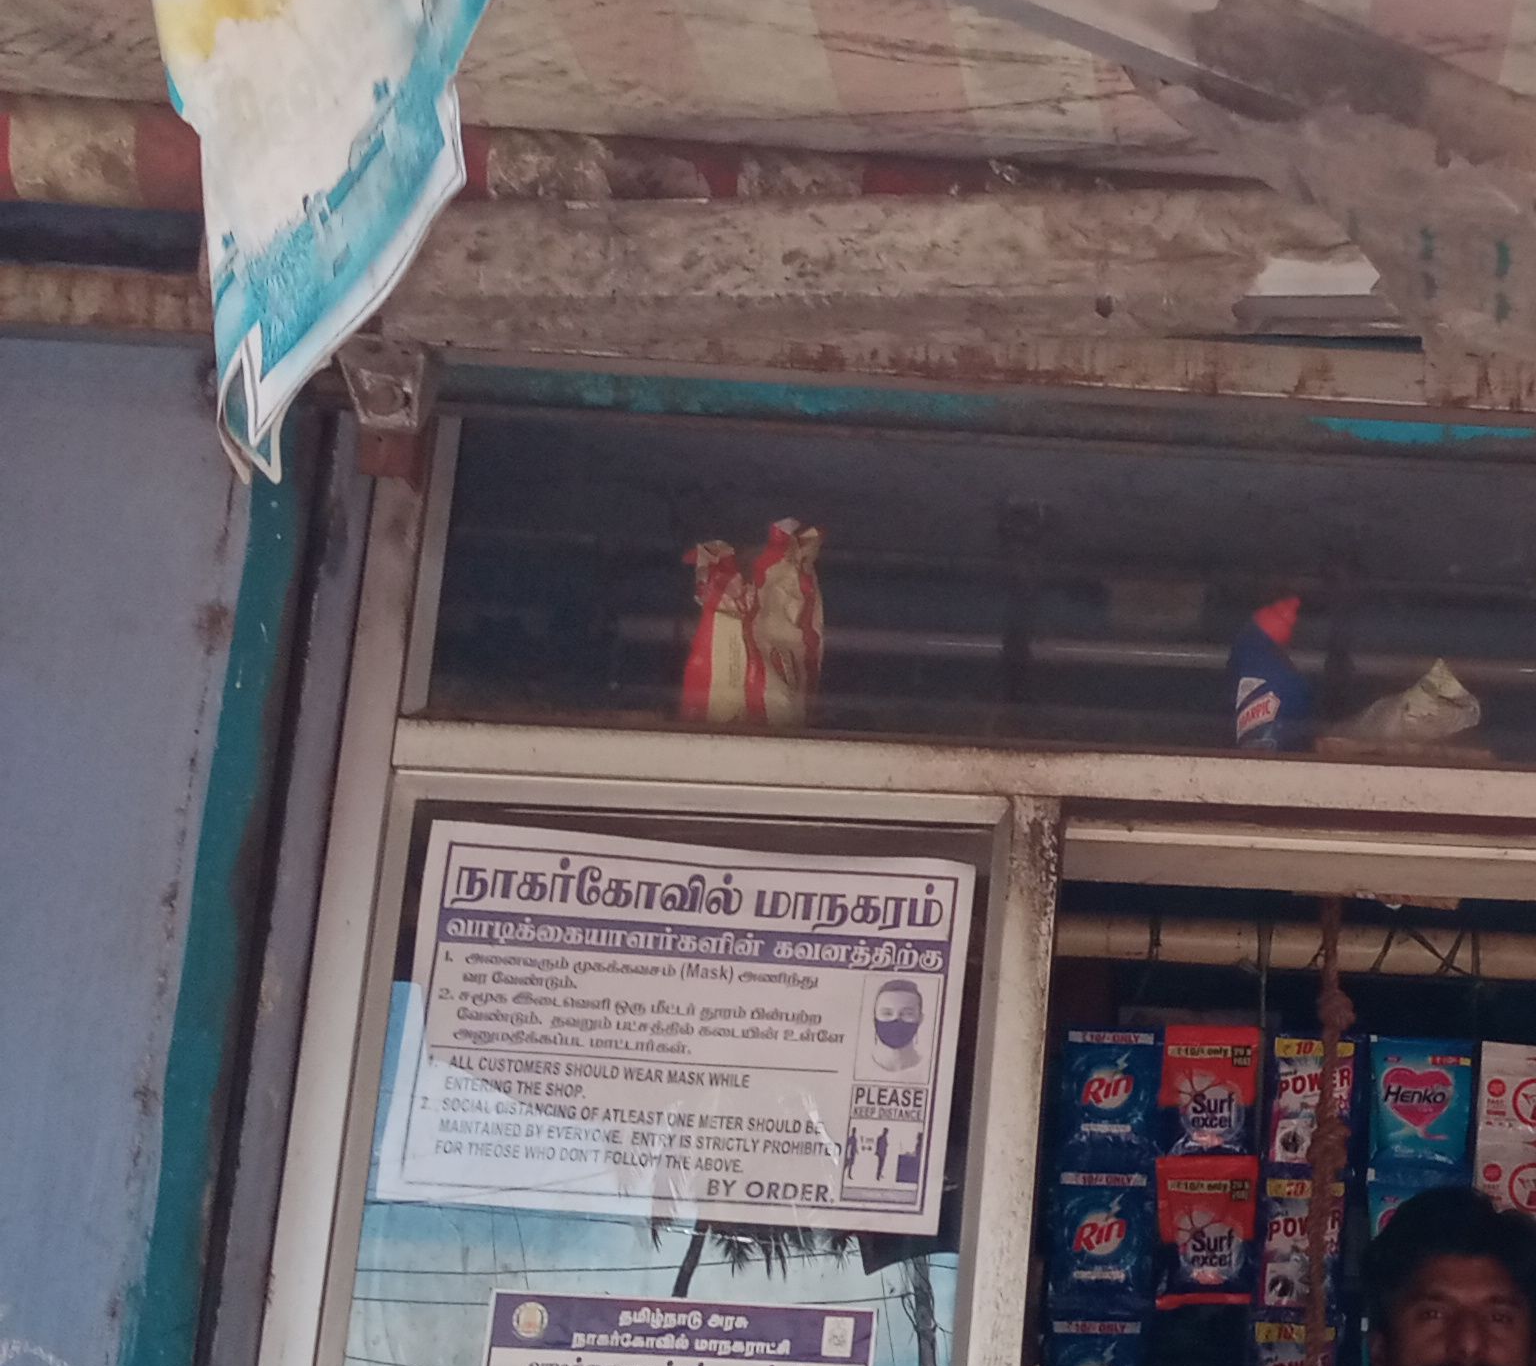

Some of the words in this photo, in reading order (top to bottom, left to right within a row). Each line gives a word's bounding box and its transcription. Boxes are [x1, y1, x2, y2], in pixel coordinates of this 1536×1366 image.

[451, 857, 742, 916] நாகர்கோவில்
[755, 882, 944, 932] மாநகரம்
[446, 916, 765, 958] வாடிக்கையாளர்களின்
[772, 939, 944, 973] கவனத்திற்கு
[680, 963, 734, 983] (Mask)
[449, 1054, 474, 1071] ALL
[479, 1056, 561, 1077] CUSTOMERS
[565, 1062, 619, 1081] SHOULD
[623, 1066, 664, 1084] WEAR
[667, 1071, 705, 1088] MASK
[709, 1073, 750, 1090] WHILE
[444, 1075, 512, 1095] ENTERING
[516, 1079, 542, 1096] THE
[545, 1082, 586, 1100] SHOP.
[853, 1086, 923, 1109] PLEASE
[1081, 1075, 1136, 1106] Rin
[1384, 1085, 1446, 1104] Henko
[1191, 1091, 1235, 1115] Surf
[441, 1097, 491, 1114] SOCIAL
[495, 1099, 577, 1120] DISTANCING
[580, 1105, 601, 1122] OF
[602, 1108, 664, 1127] ATLEAST
[667, 1111, 695, 1130] ONE
[699, 1114, 744, 1133] METER
[747, 1117, 802, 1135] SHOULD
[1191, 1115, 1232, 1129] excel
[438, 1117, 522, 1137] MAINTAINED
[525, 1123, 544, 1140] BY
[630, 1130, 675, 1150] ENTRY
[679, 1134, 692, 1151] IS
[696, 1136, 761, 1154] STRICTLY
[763, 1139, 843, 1158] PROHIBITED
[435, 1139, 463, 1155] FOR
[466, 1142, 521, 1160] THEOSE
[524, 1145, 557, 1161] WHO
[560, 1148, 600, 1165] DON'T
[665, 1155, 691, 1172] THE
[694, 1157, 744, 1174] ABOVE.
[706, 1178, 731, 1198] BY
[745, 1180, 835, 1205] ORDER.
[1073, 1218, 1128, 1254] Rin
[1191, 1228, 1235, 1253] Surf
[1190, 1253, 1233, 1267] excel
[619, 1308, 703, 1330] தமிழ்நாடு
[707, 1314, 750, 1330] அரசு
[571, 1331, 690, 1352] நாகர்கோவில்
